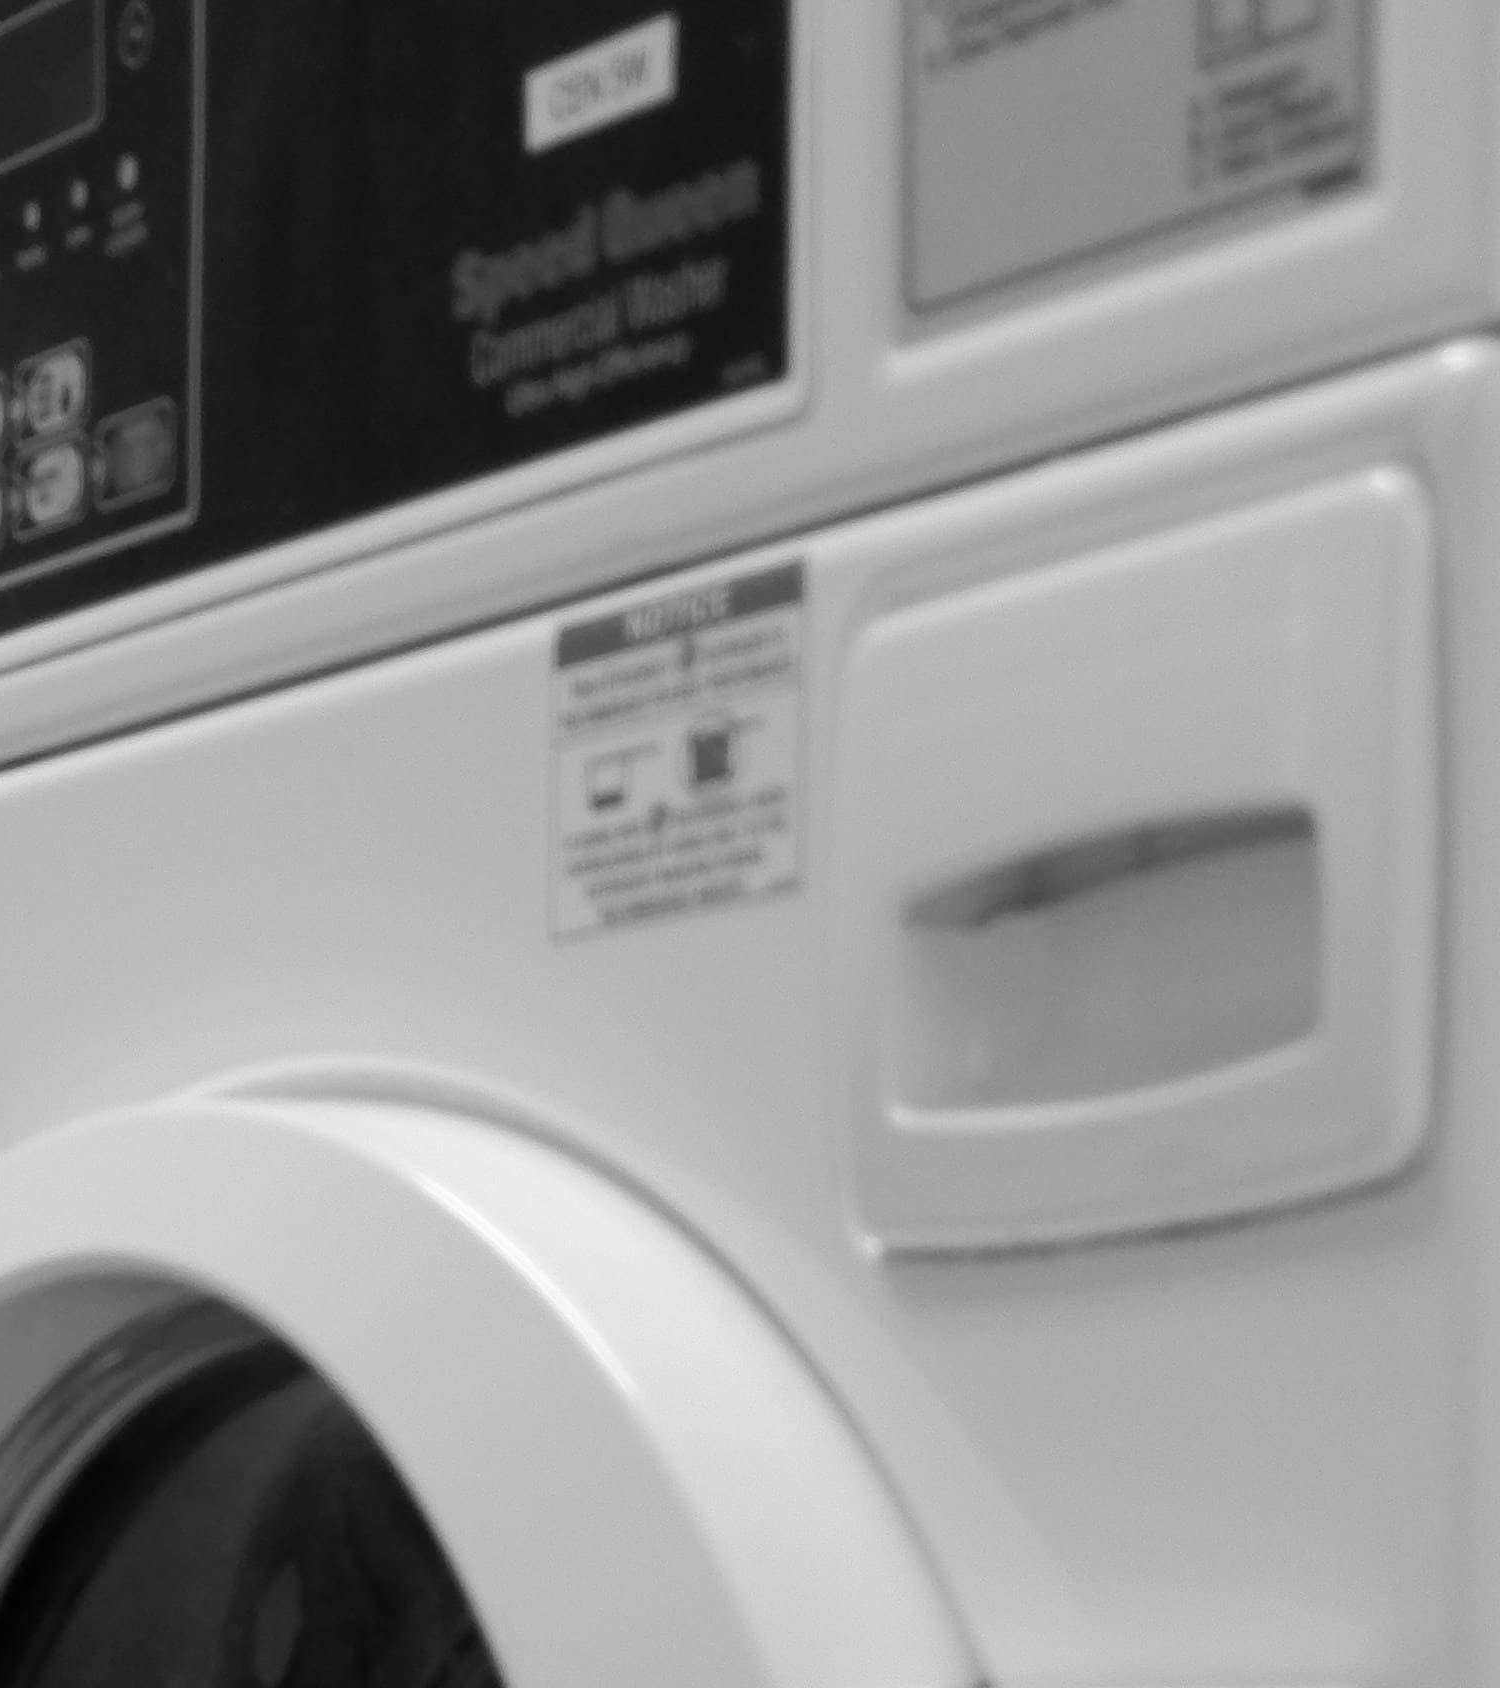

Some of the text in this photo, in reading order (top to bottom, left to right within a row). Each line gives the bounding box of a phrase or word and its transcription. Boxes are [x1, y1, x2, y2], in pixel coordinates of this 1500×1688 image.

[452, 157, 762, 325] Speed Queen
[470, 293, 620, 389] Commercial
[626, 255, 729, 329] Washer
